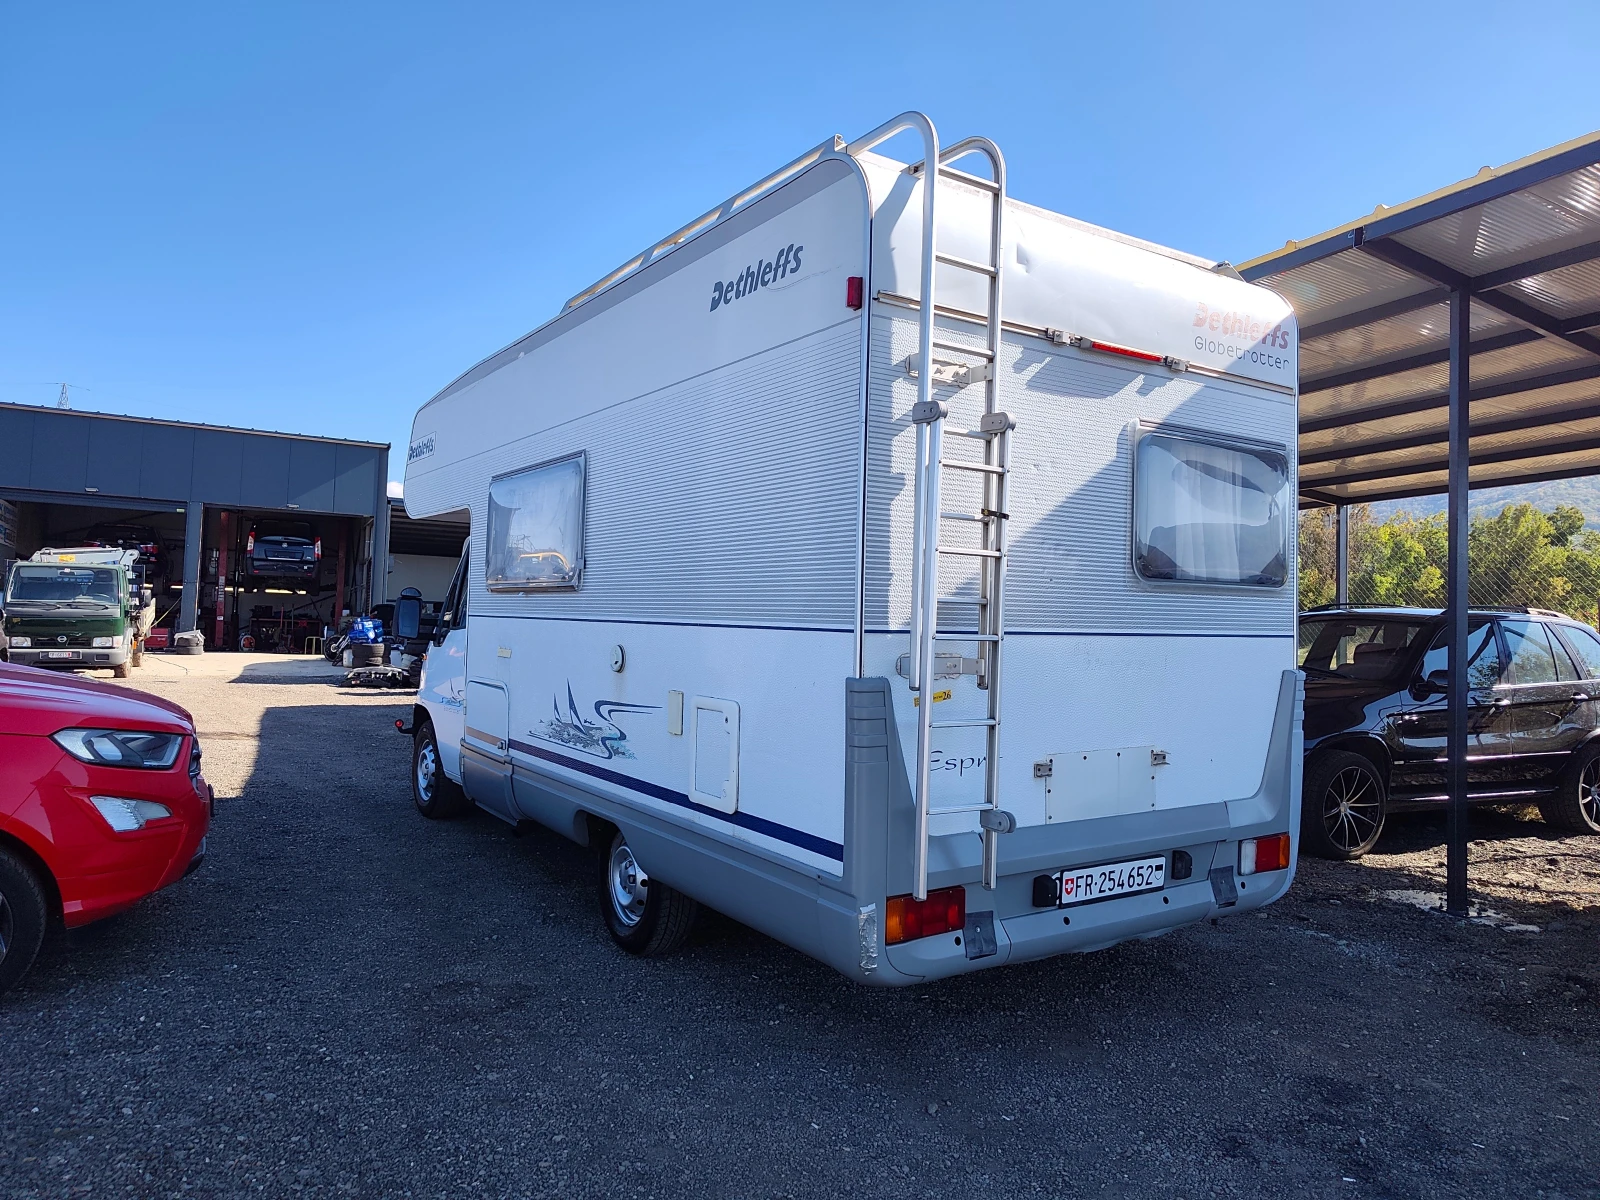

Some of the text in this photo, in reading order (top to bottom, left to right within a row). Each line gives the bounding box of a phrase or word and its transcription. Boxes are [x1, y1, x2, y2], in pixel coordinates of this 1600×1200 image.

[709, 243, 803, 312] Dethleffs
[1193, 302, 1289, 349] Dethleffs
[1194, 336, 1290, 369] Globetrotter
